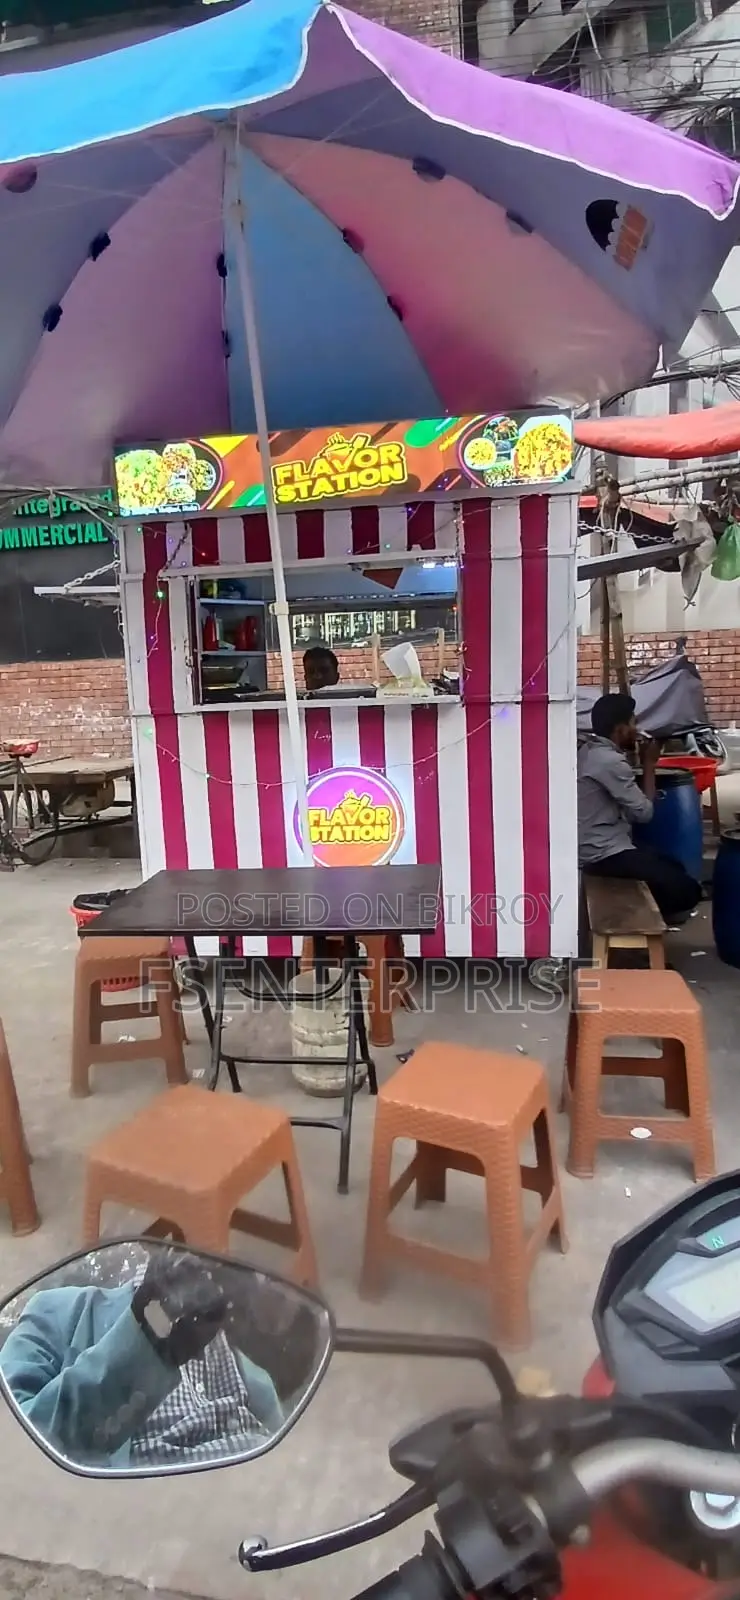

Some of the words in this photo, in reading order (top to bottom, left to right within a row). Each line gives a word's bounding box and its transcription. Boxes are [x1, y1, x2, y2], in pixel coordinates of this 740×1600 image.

[274, 440, 402, 486] FLAVOR
[275, 462, 403, 503] STATION
[308, 806, 391, 827] FLAVOR
[711, 1235, 725, 1249] N
